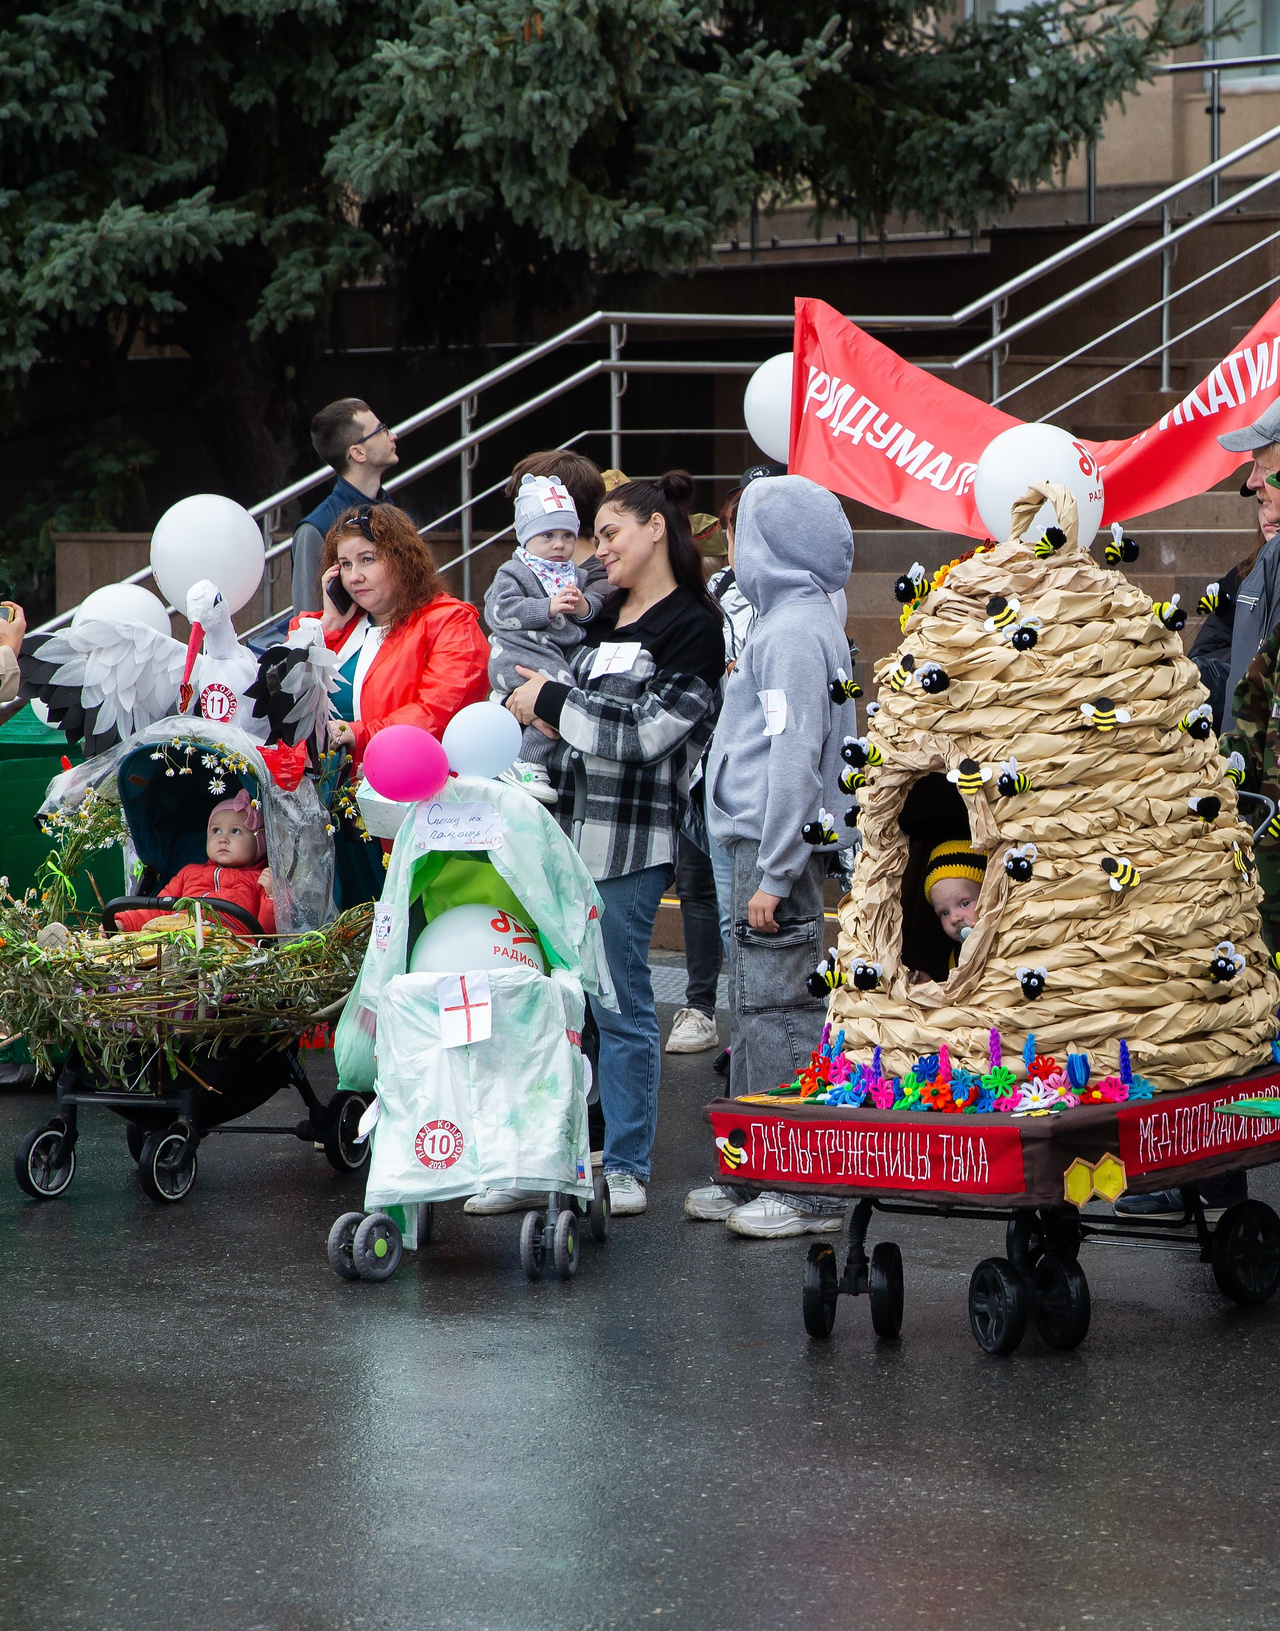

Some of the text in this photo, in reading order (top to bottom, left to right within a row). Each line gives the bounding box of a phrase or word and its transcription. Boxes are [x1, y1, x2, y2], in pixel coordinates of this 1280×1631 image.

[210, 696, 224, 714] 11
[213, 683, 237, 720] КОЛЯСОК
[427, 803, 483, 829] Спешу на
[415, 1120, 463, 1161] ПАРАД КОЛЯСОК
[428, 1134, 451, 1155] 10
[750, 1121, 989, 1184] ПЧЁЛЫ-ТРУЖЕНИЦЫ ТЫЛА
[428, 1160, 447, 1170] 2025
